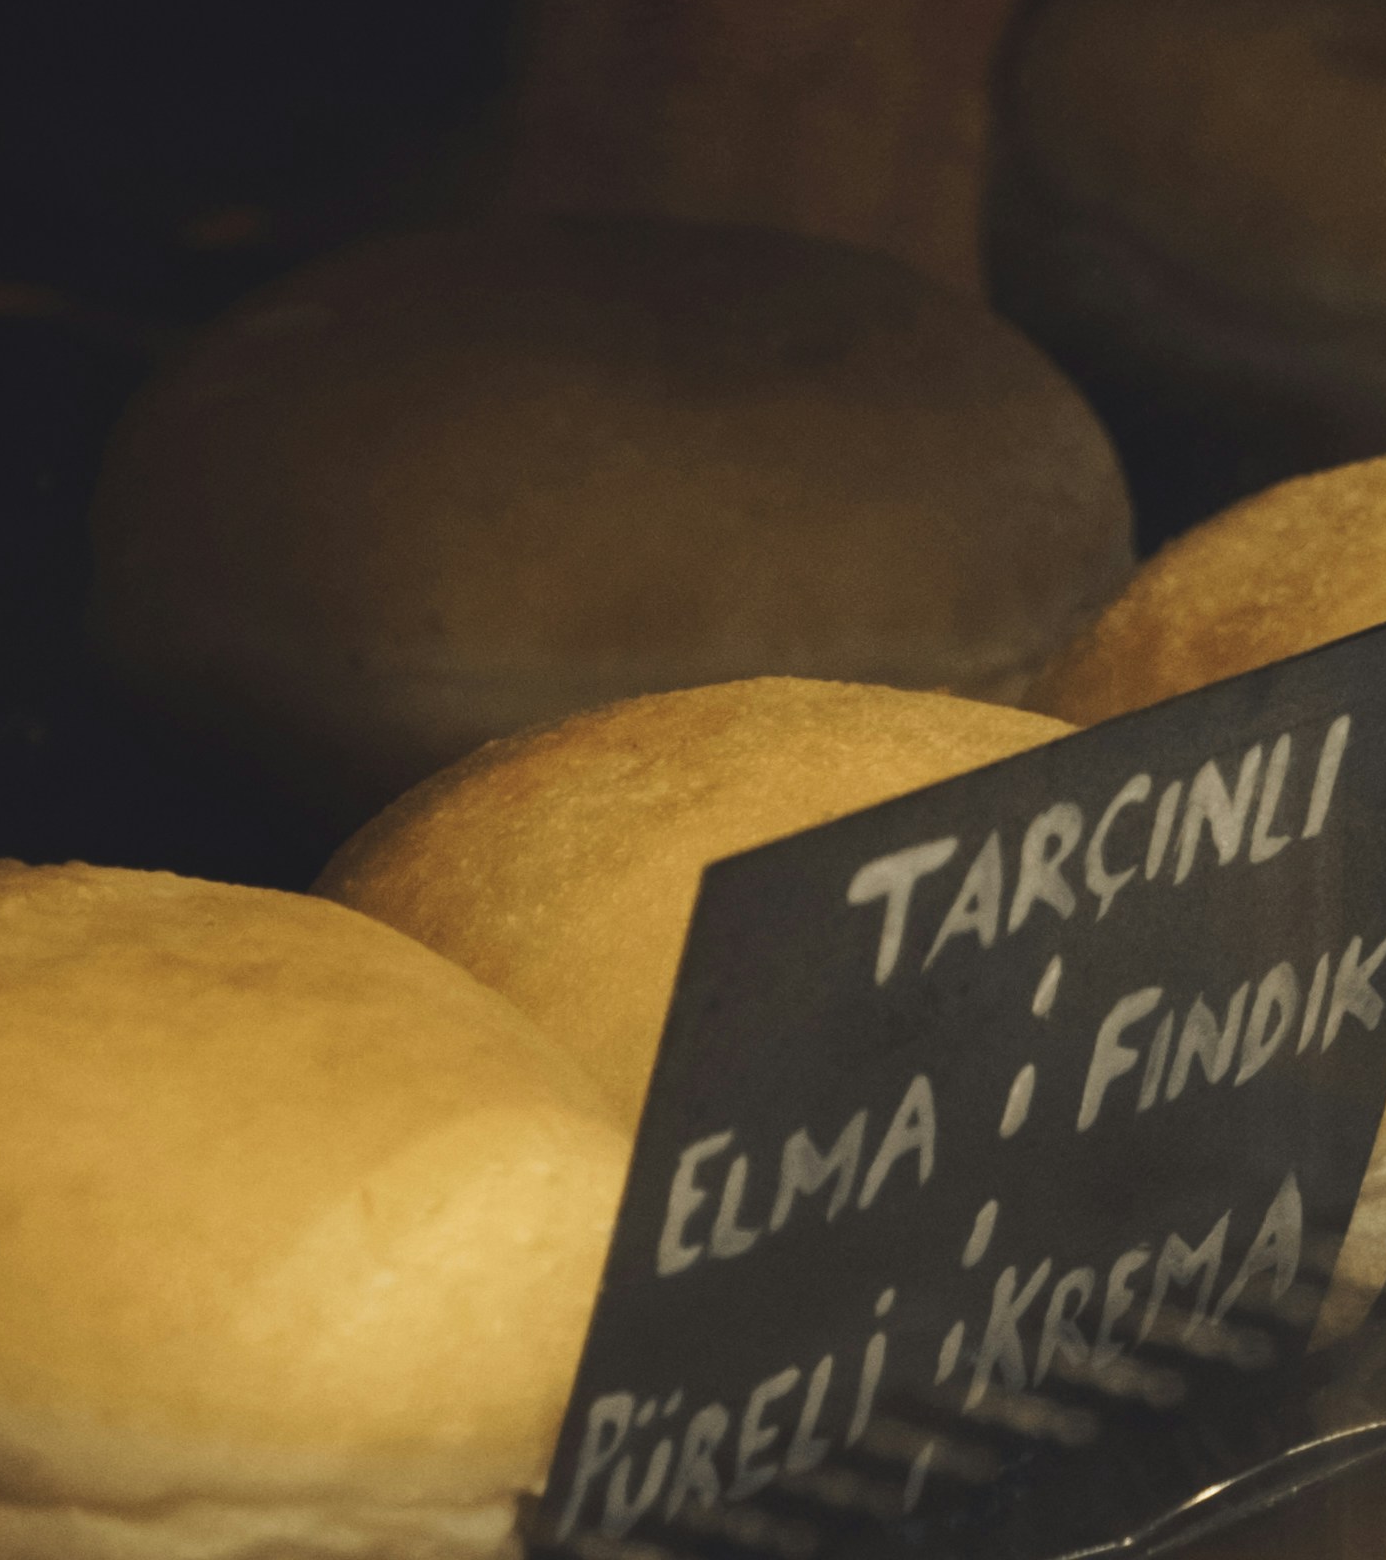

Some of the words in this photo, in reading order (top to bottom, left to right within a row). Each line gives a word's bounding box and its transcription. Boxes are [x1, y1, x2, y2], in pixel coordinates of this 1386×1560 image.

[846, 714, 1352, 986] TARÇINLI
[655, 1073, 937, 1278] ELMA
[960, 1170, 1304, 1416] KREMA
[555, 1287, 897, 1544] PÜRELİ
